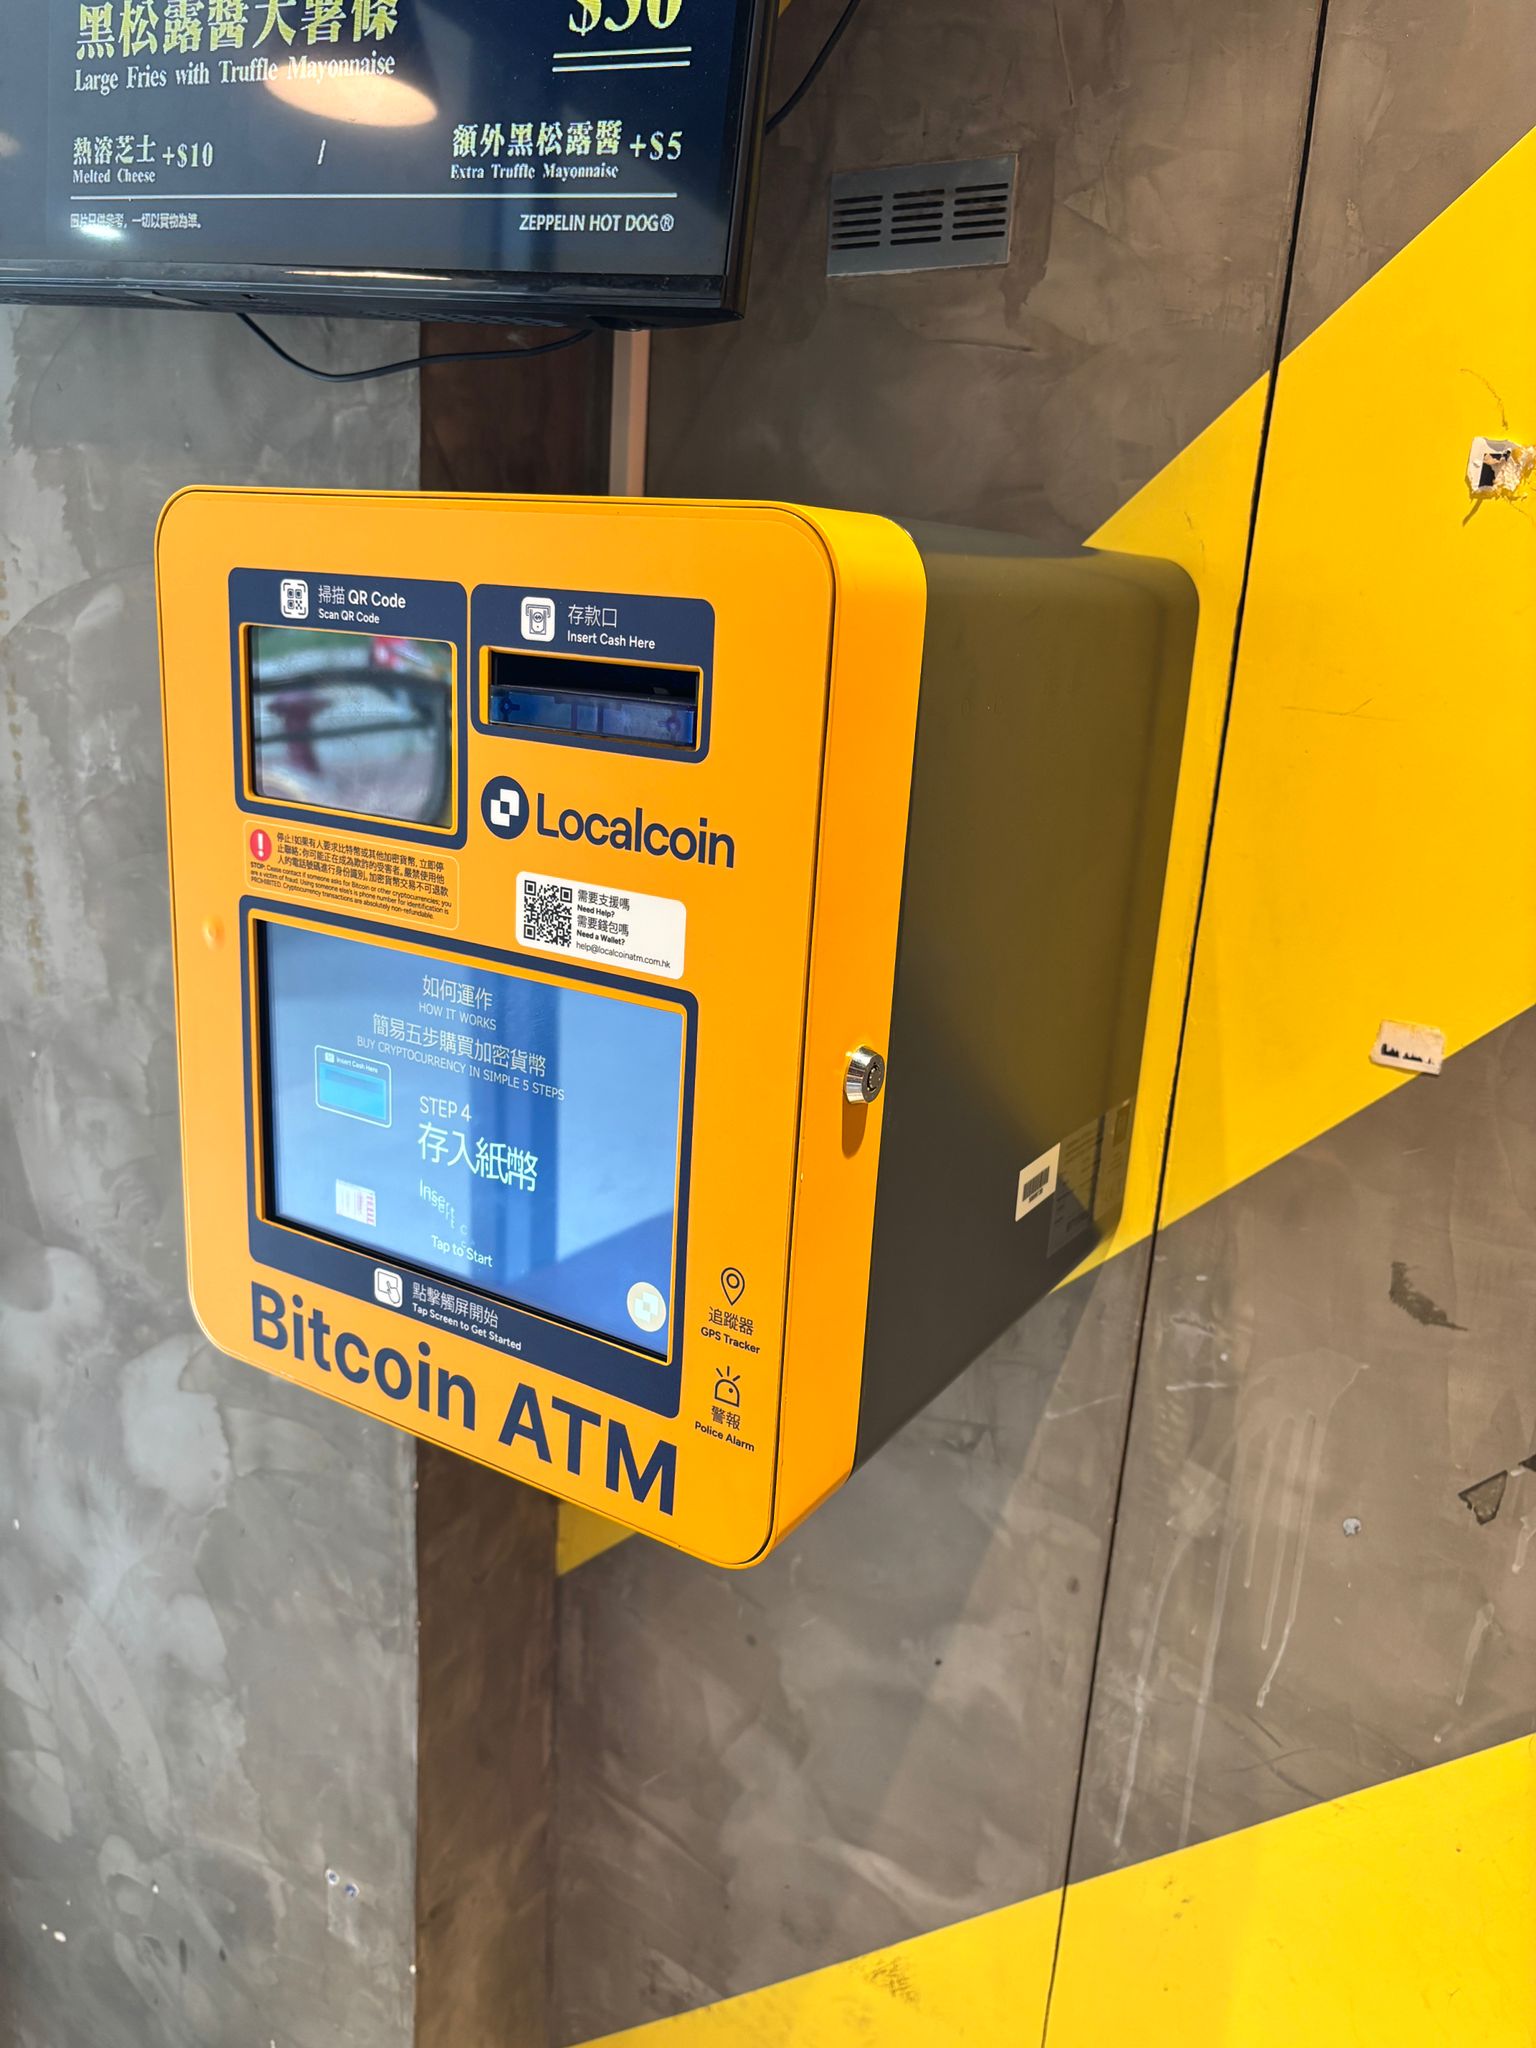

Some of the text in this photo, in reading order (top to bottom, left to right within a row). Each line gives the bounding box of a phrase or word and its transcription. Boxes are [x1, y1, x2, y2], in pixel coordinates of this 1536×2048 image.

[74, 50, 396, 95] Large Fries with Truffle Mayonnaise
[73, 135, 213, 168] 熱溶芝士 +$10
[452, 119, 623, 158] 額外黑松露醬
[73, 168, 156, 184] Melted Cheese
[450, 162, 619, 182] Extra Truffle Mayonnaise
[519, 213, 585, 231] ZEPPELIN
[589, 213, 622, 231] HOT
[318, 584, 406, 609] 掃描 QR Code
[318, 608, 380, 624] Scan QR Code
[568, 604, 618, 629] 存款口
[567, 630, 656, 650] Insert Cash Here
[537, 792, 735, 869] Localcoin
[263, 872, 278, 880] victim
[300, 879, 315, 889] Using
[315, 882, 338, 892] someone
[359, 891, 376, 900] phone
[376, 894, 397, 904] number
[397, 898, 406, 906] for
[407, 900, 444, 913] identification
[283, 882, 322, 898] Cryptocurrency
[322, 891, 354, 903] transactions
[363, 900, 391, 912] absolutely
[307, 873, 330, 883] someone
[342, 879, 351, 887] for
[351, 881, 370, 891] Bitcoin
[377, 887, 391, 895] other
[441, 900, 452, 909] you
[578, 889, 630, 911] 需要支援嗎
[577, 904, 615, 918] Need Help?
[577, 915, 629, 937] 需要錢包嗎
[576, 929, 594, 939] Need
[600, 935, 625, 946] Wallet?
[576, 941, 671, 969] help@localcoinatm.com.hk
[422, 974, 494, 1012] 如何運作
[418, 1002, 497, 1032] HOW IT WORKS
[372, 1013, 547, 1079] 簡易五步購買加密貨幣
[357, 1035, 565, 1101] BUY CRYPTOCURRENCY IN SIMPLE 5 STEPS
[419, 1096, 472, 1122] STEP 4
[417, 1121, 539, 1192] 存入紙幣
[431, 1234, 450, 1254] Tap
[452, 1243, 465, 1257] to
[466, 1247, 493, 1268] Start
[412, 1281, 498, 1329] 點擊觸屏開始
[412, 1302, 522, 1351] Tap Screen to Get Started
[708, 1306, 753, 1336] 追蹤器
[701, 1326, 760, 1354] GPS Tracker
[251, 1280, 678, 1517] Bitcoin ATM
[711, 1405, 740, 1431] 警報
[695, 1420, 755, 1452] Police Alarm
